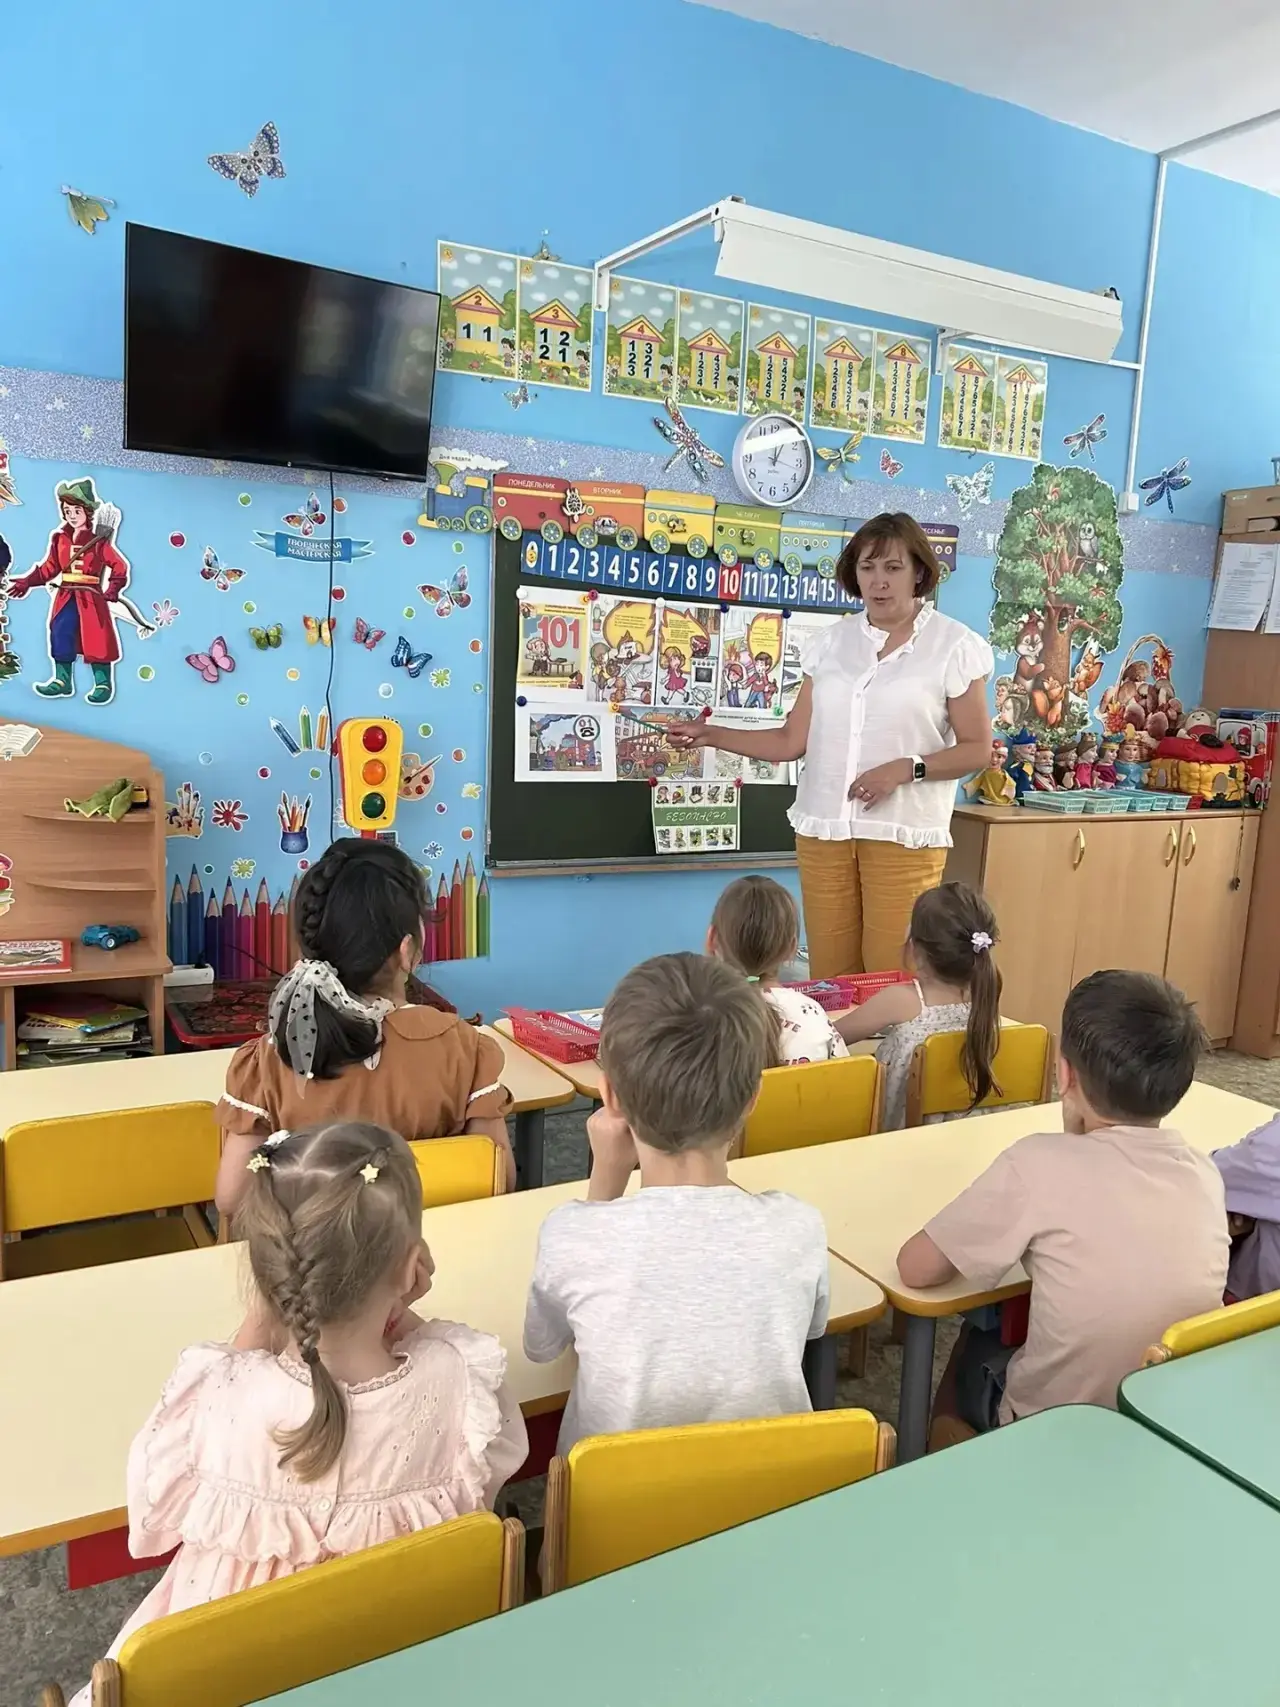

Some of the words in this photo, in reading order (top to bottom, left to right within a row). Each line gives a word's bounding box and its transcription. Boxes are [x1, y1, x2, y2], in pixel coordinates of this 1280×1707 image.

[475, 296, 482, 305] 2
[552, 309, 559, 319] 3
[463, 323, 470, 338] 1
[483, 327, 491, 342] 1
[638, 325, 644, 334] 4
[540, 328, 548, 343] 1
[560, 332, 569, 346] 2
[707, 337, 712, 346] 5
[629, 340, 635, 351] 1
[645, 343, 652, 354] 3
[775, 340, 780, 348] 6
[540, 345, 550, 359] 2
[559, 348, 566, 362] 1
[840, 345, 846, 354] 7
[629, 353, 636, 364] 2
[645, 356, 652, 366] 2
[628, 365, 635, 376] 3
[644, 368, 649, 378] 1
[760, 427, 766, 436] 11
[745, 453, 752, 463] 9
[796, 459, 802, 468] 3
[749, 469, 756, 479] 8
[791, 473, 796, 482] 4
[508, 478, 555, 489] ПОНЕДЕЛЬНИК
[758, 482, 764, 492] 7
[783, 483, 789, 492] 5
[593, 487, 622, 495] ВТОРНИК
[770, 487, 776, 496] 6
[288, 538, 342, 549] ТВОРЧЕСКАЯ
[288, 548, 341, 558] МАСТЕРСКАЯ
[526, 541, 538, 568] 0
[549, 545, 557, 571] 1
[568, 548, 579, 575] 2
[588, 551, 599, 577] 3
[608, 555, 620, 580] 4
[628, 558, 640, 583] 5
[648, 560, 659, 585] 6
[668, 563, 679, 588] 7
[686, 565, 697, 590] 8
[706, 567, 715, 591] 9
[722, 569, 739, 594] 10
[744, 572, 758, 596] 11
[763, 574, 777, 598] 12
[782, 576, 798, 599] 13
[802, 577, 817, 601] 14
[822, 579, 835, 602] 15
[537, 616, 579, 648] 101
[579, 719, 592, 728] 01
[666, 812, 726, 822] БЕЗОПАСНО
[780, 1018, 801, 1032] TE
